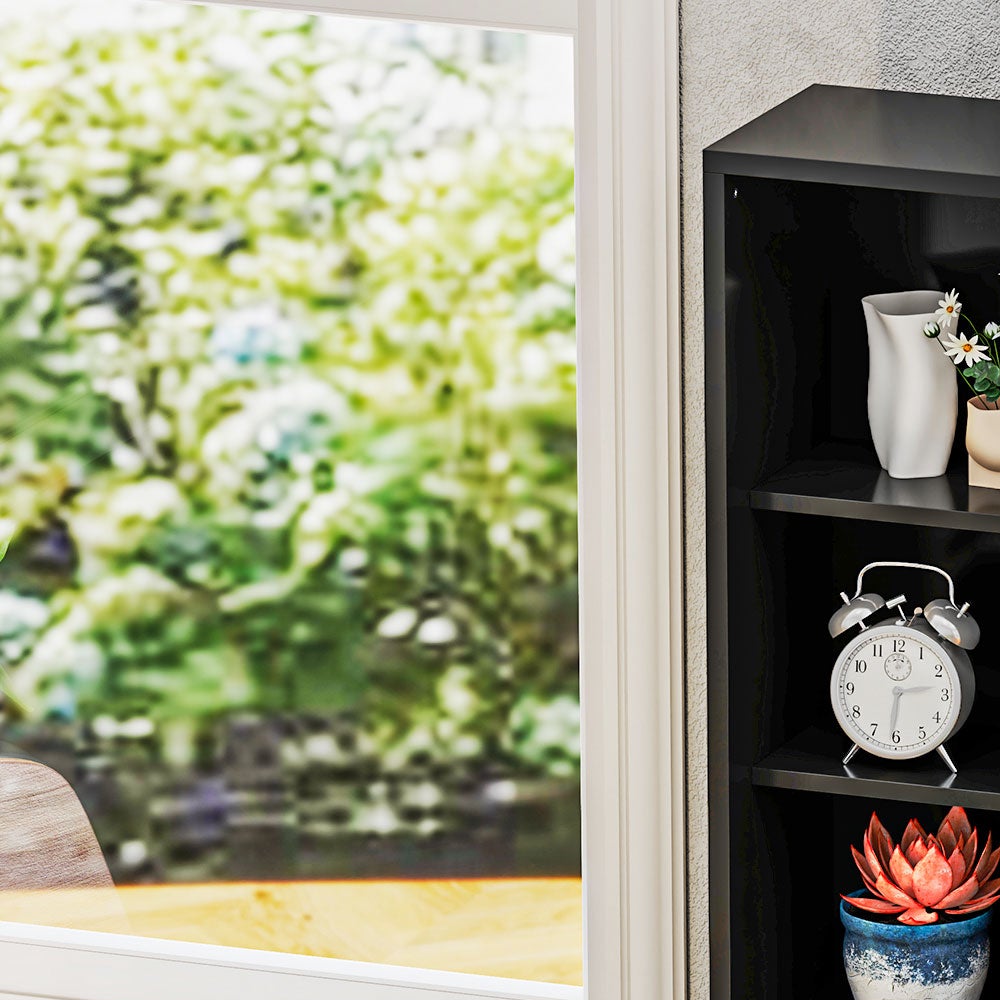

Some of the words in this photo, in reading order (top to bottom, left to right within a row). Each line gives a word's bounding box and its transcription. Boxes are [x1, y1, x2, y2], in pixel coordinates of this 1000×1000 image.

[873, 644, 883, 657] 11
[893, 640, 906, 652] 12
[919, 647, 924, 660] 1
[855, 660, 867, 673] 10
[934, 665, 943, 678] 2
[846, 682, 855, 696] 9
[941, 688, 949, 701] 3
[852, 705, 861, 718] 8
[932, 711, 941, 723] 4
[870, 723, 878, 736] 7
[918, 726, 926, 739] 5
[892, 730, 901, 744] 6
